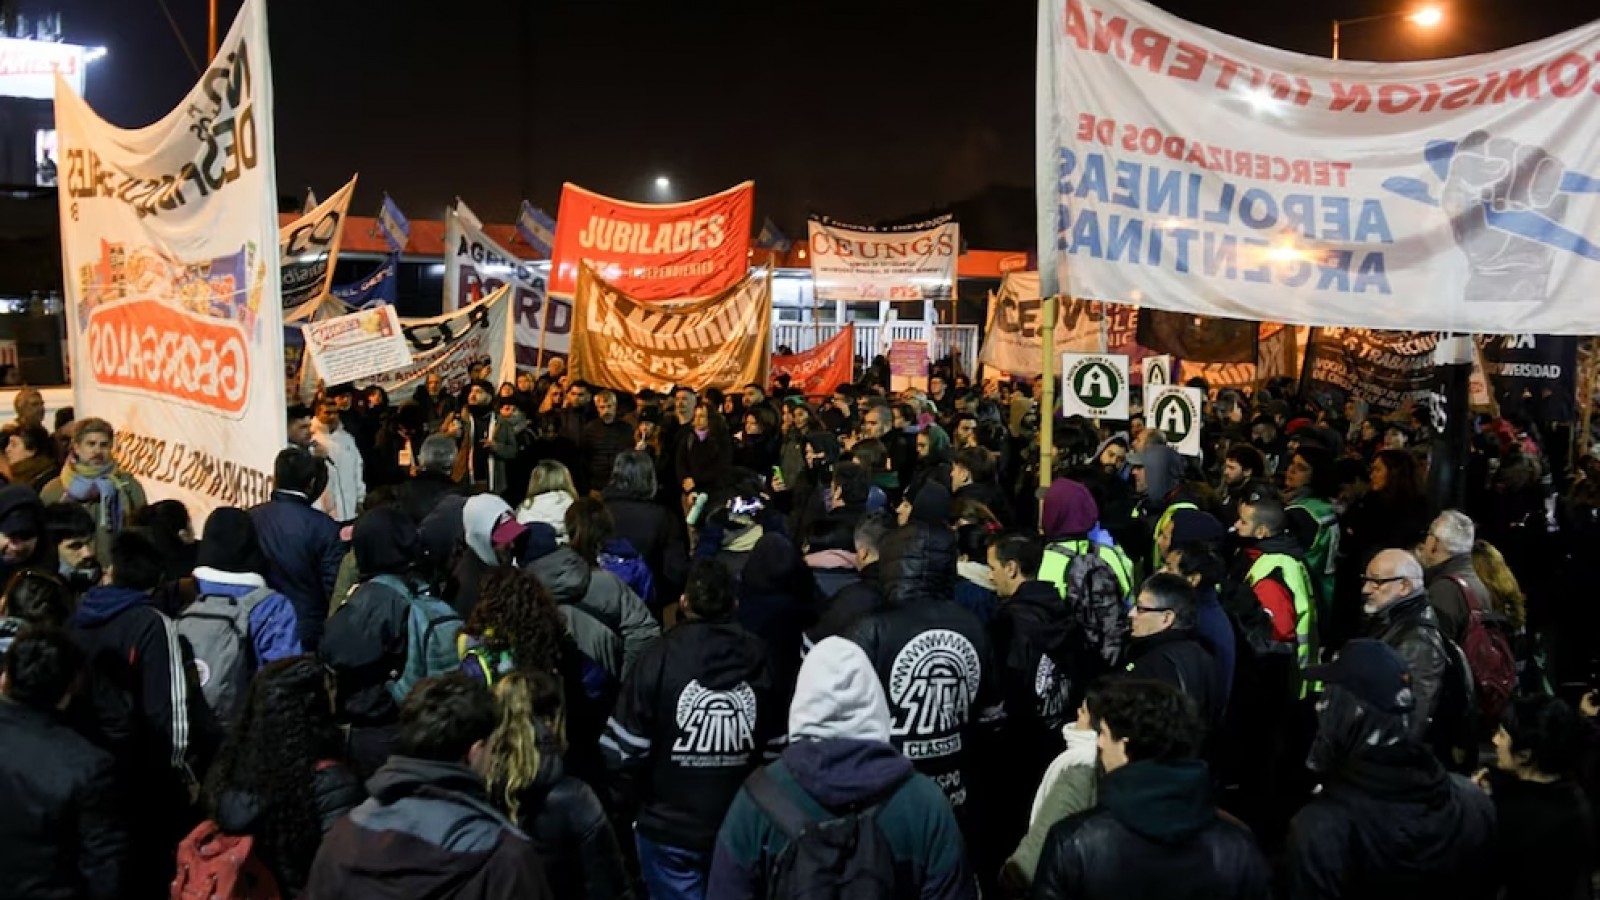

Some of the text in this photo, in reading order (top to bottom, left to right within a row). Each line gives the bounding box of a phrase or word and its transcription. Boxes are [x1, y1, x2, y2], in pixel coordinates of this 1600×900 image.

[579, 213, 726, 254] JUBILADES
[812, 231, 955, 260] CEUNGS
[672, 708, 756, 753] SUTNA
